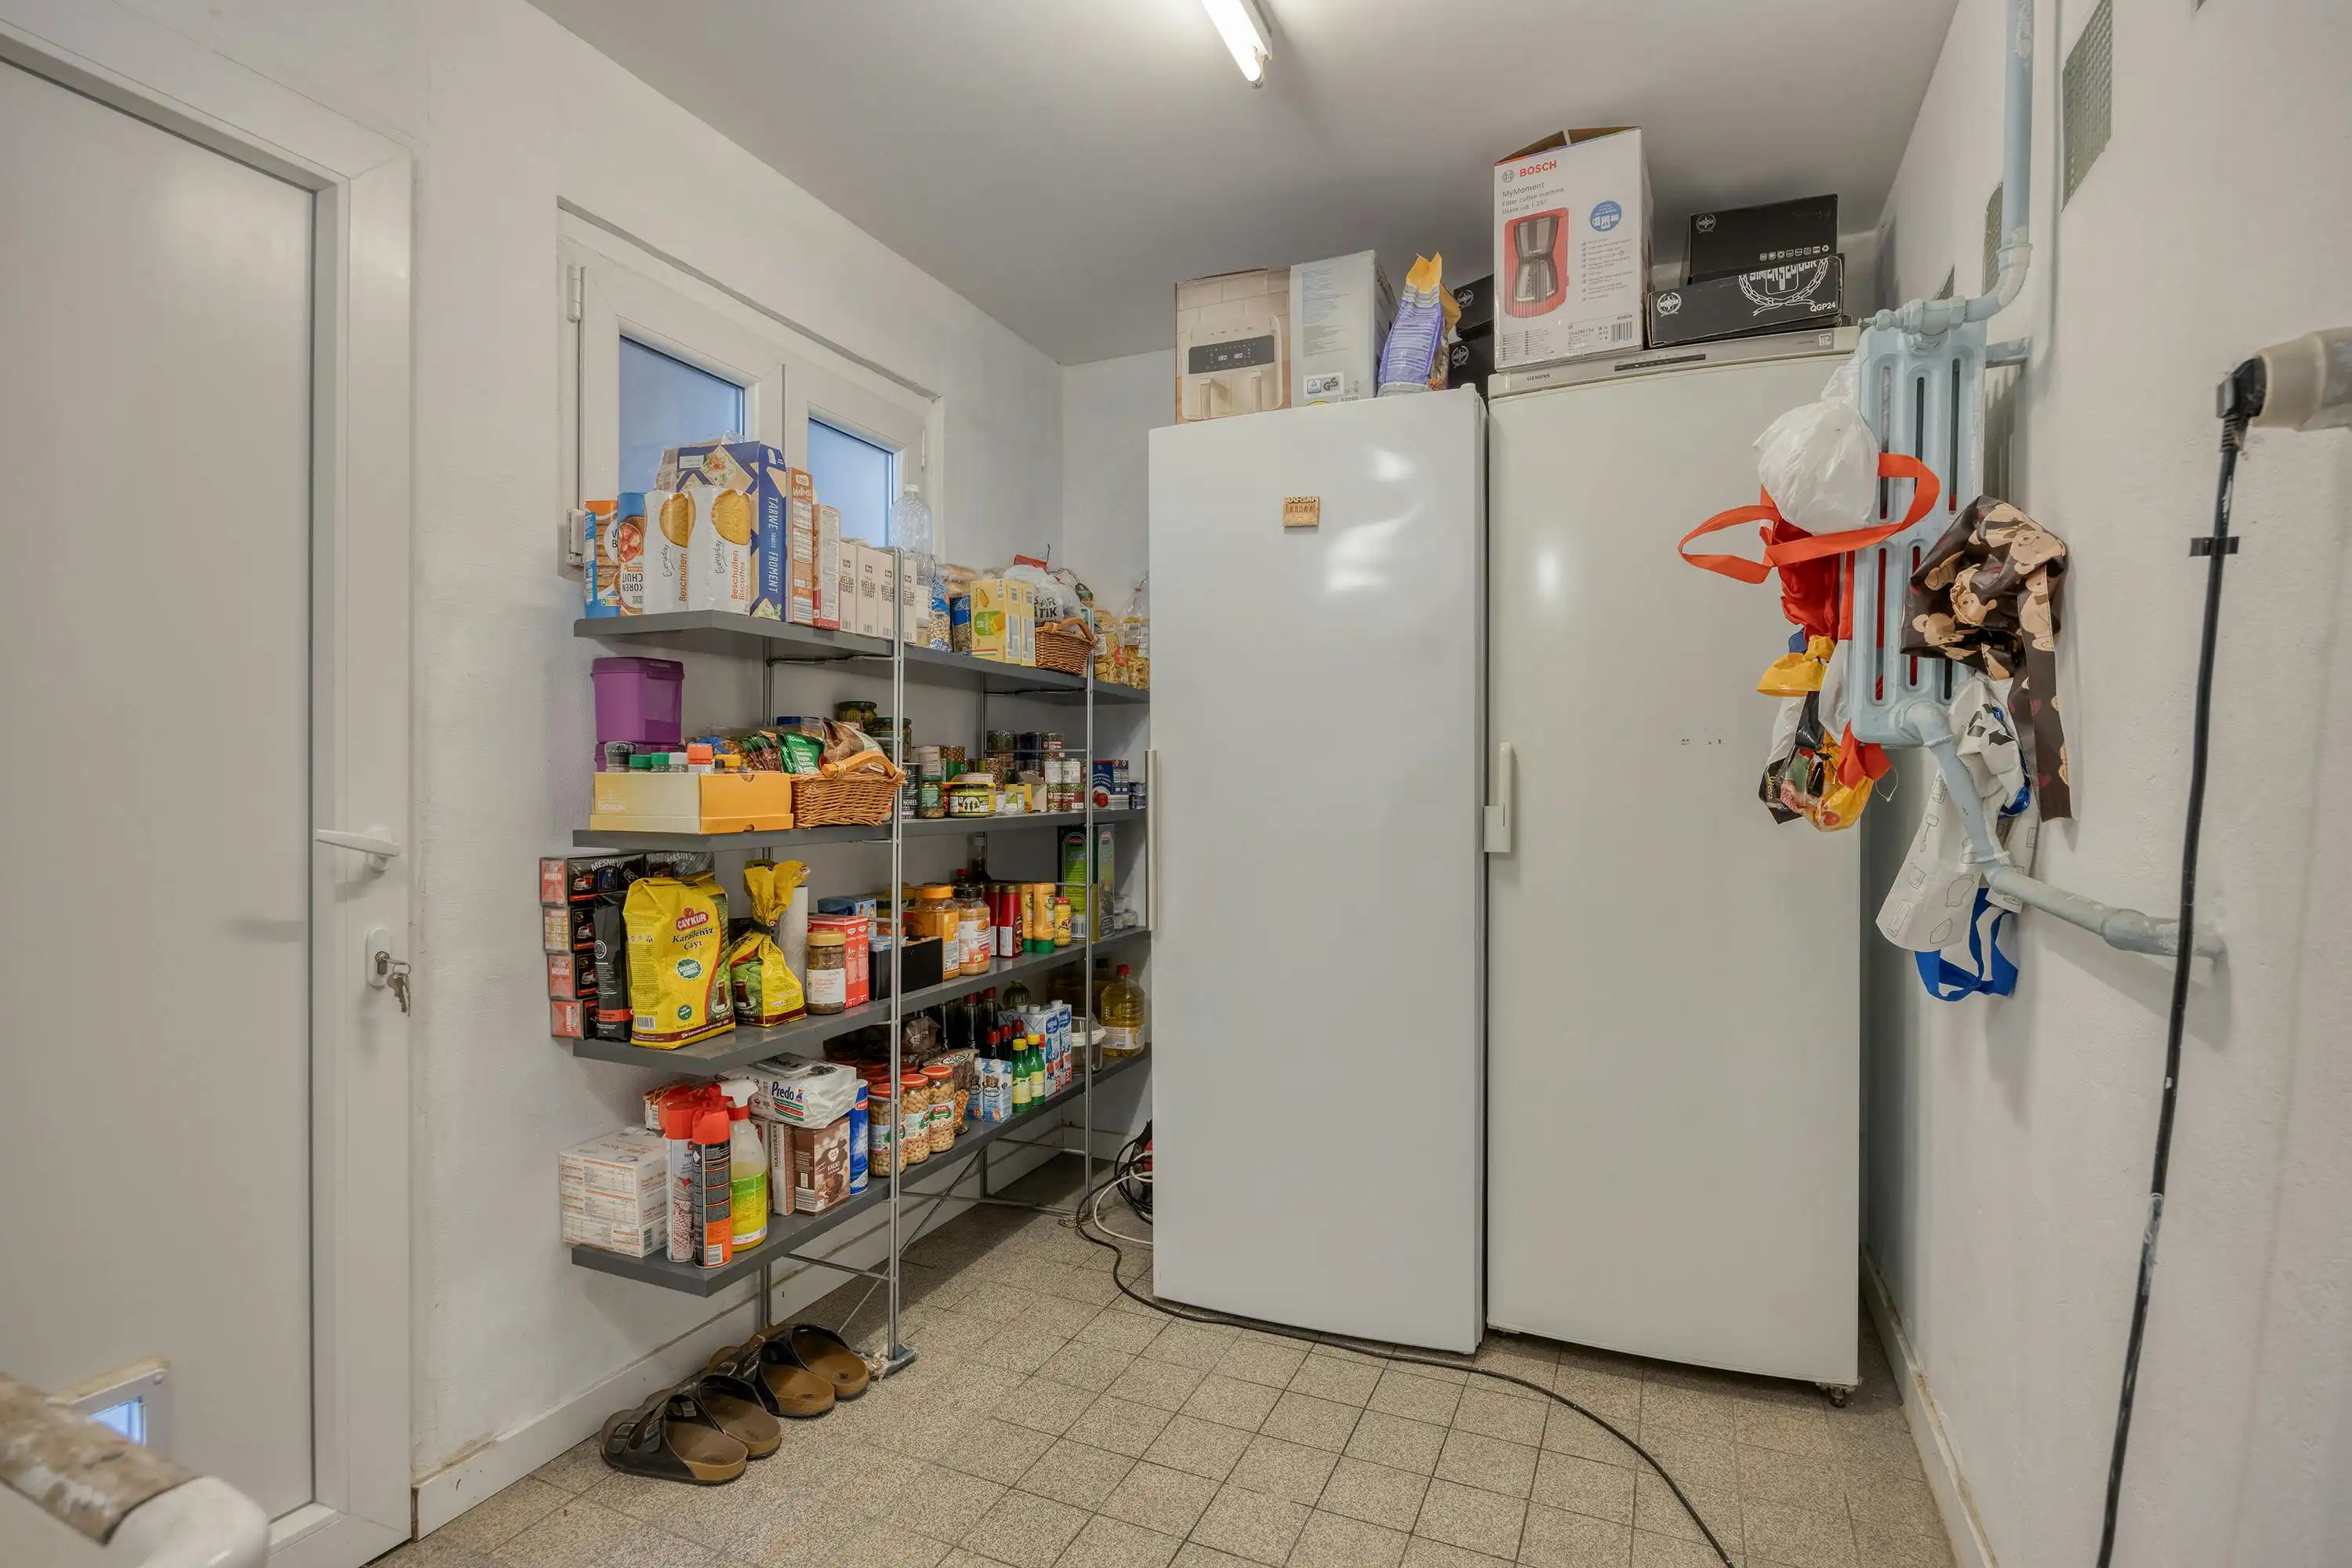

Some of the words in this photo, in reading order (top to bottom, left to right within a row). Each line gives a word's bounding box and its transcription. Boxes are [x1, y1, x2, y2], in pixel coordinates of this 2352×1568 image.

[1519, 160, 1557, 177] BOSCH
[1502, 182, 1545, 198] MyMoment
[1519, 194, 1537, 203] coffee
[1539, 187, 1565, 198] machine
[1810, 302, 1836, 312] QGP24
[768, 496, 779, 535] TARWE
[678, 553, 687, 602] Beschuiten
[731, 550, 739, 601] Beschuiten
[768, 551, 779, 593] FROMENT
[903, 590, 915, 600] ELBA
[672, 927, 714, 943] Karadeniz
[771, 1081, 794, 1101] Predo
